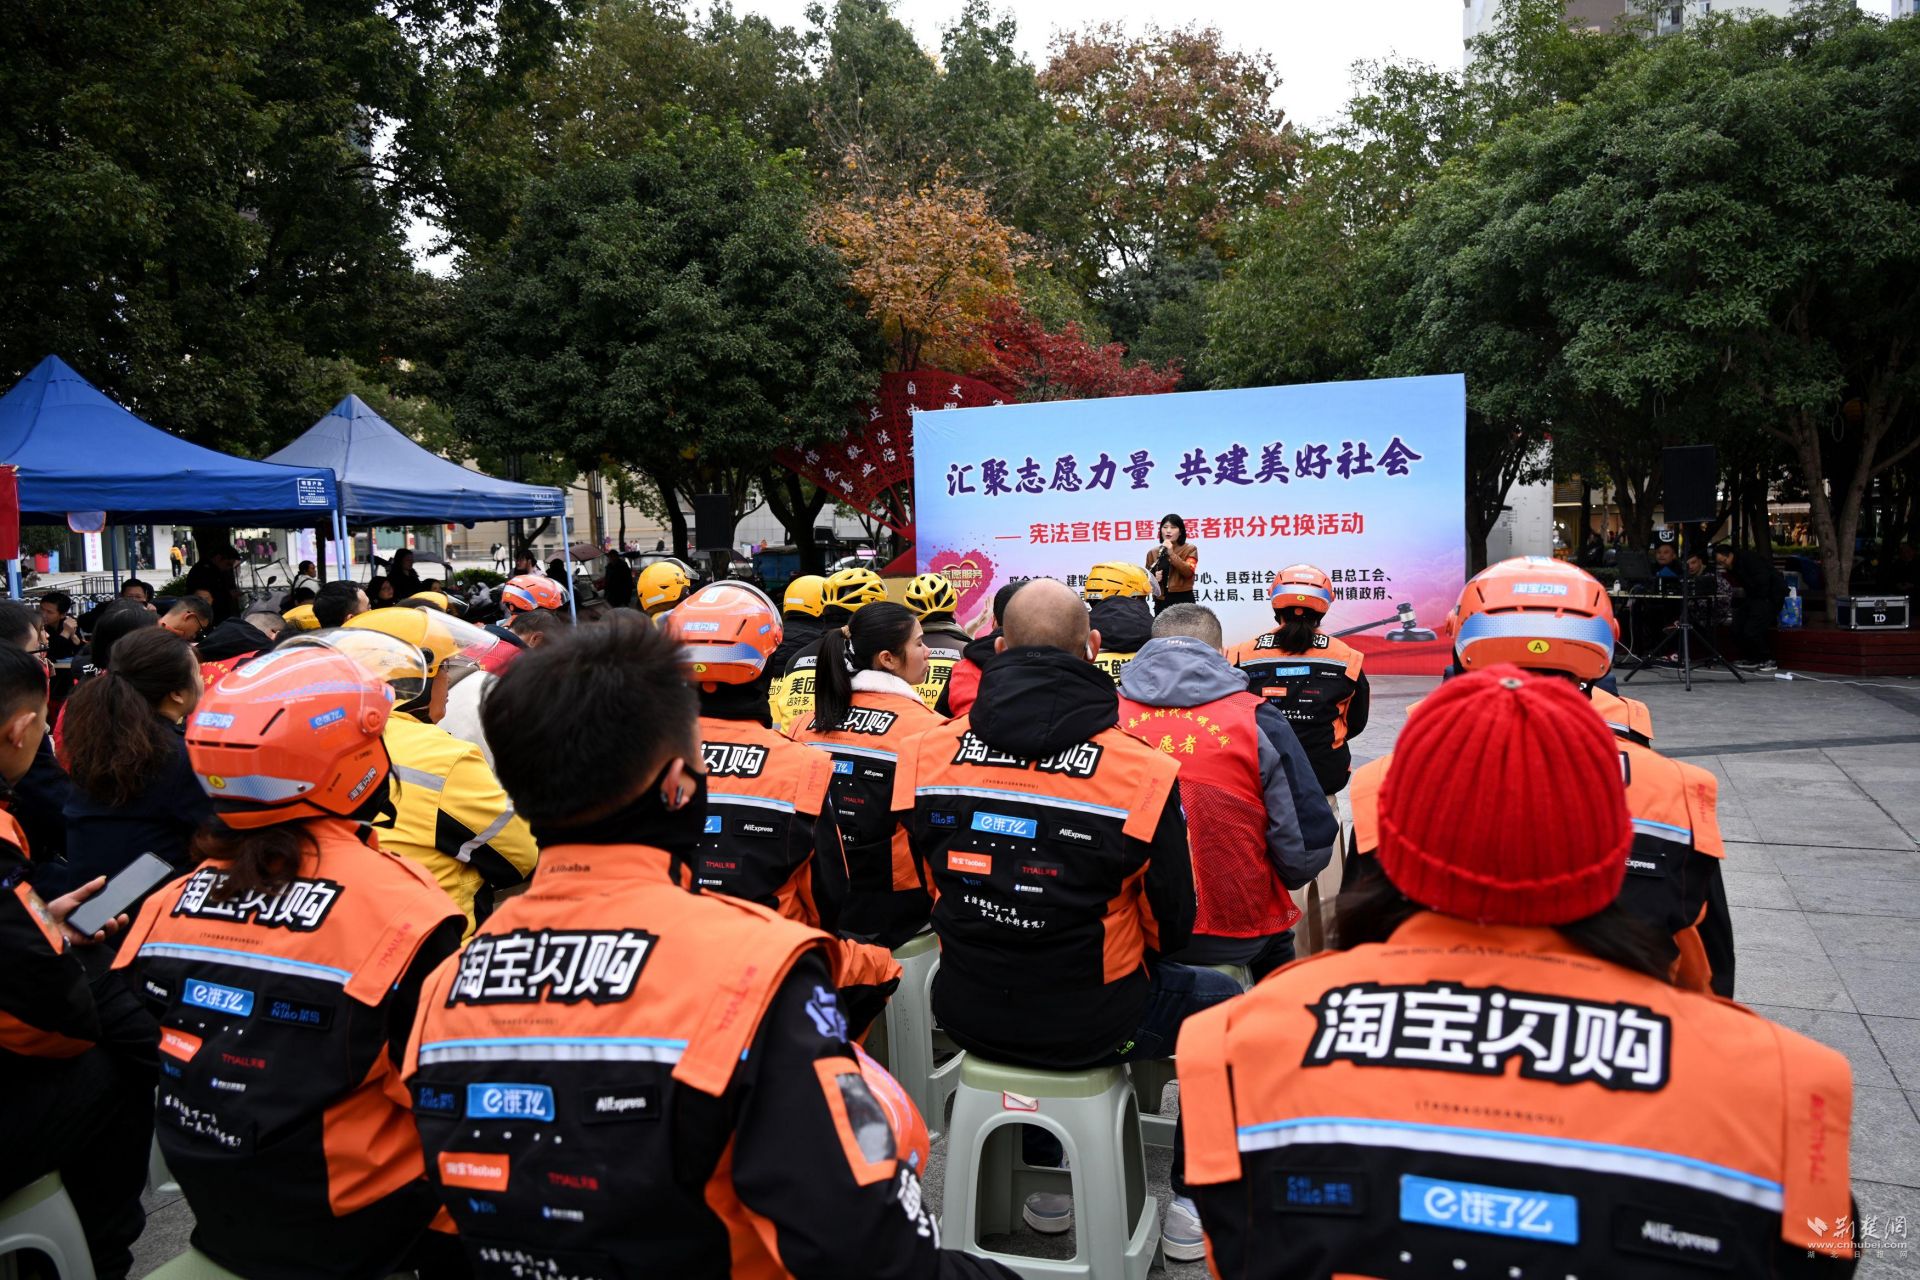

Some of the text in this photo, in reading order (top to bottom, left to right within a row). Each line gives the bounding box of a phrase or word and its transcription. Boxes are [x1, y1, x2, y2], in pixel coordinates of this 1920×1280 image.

[946, 436, 1423, 497] 汇聚志愿力量 共建美好社会
[1029, 512, 1364, 544] 宪法宣传日暨愿者积分兑换活动
[1059, 827, 1092, 841] AliExpress
[450, 931, 650, 1001] 淘宝闪购
[1314, 987, 1664, 1087] 淘宝闪购
[596, 1096, 647, 1113] AliExpress
[1641, 1220, 1720, 1253] AliExpress
